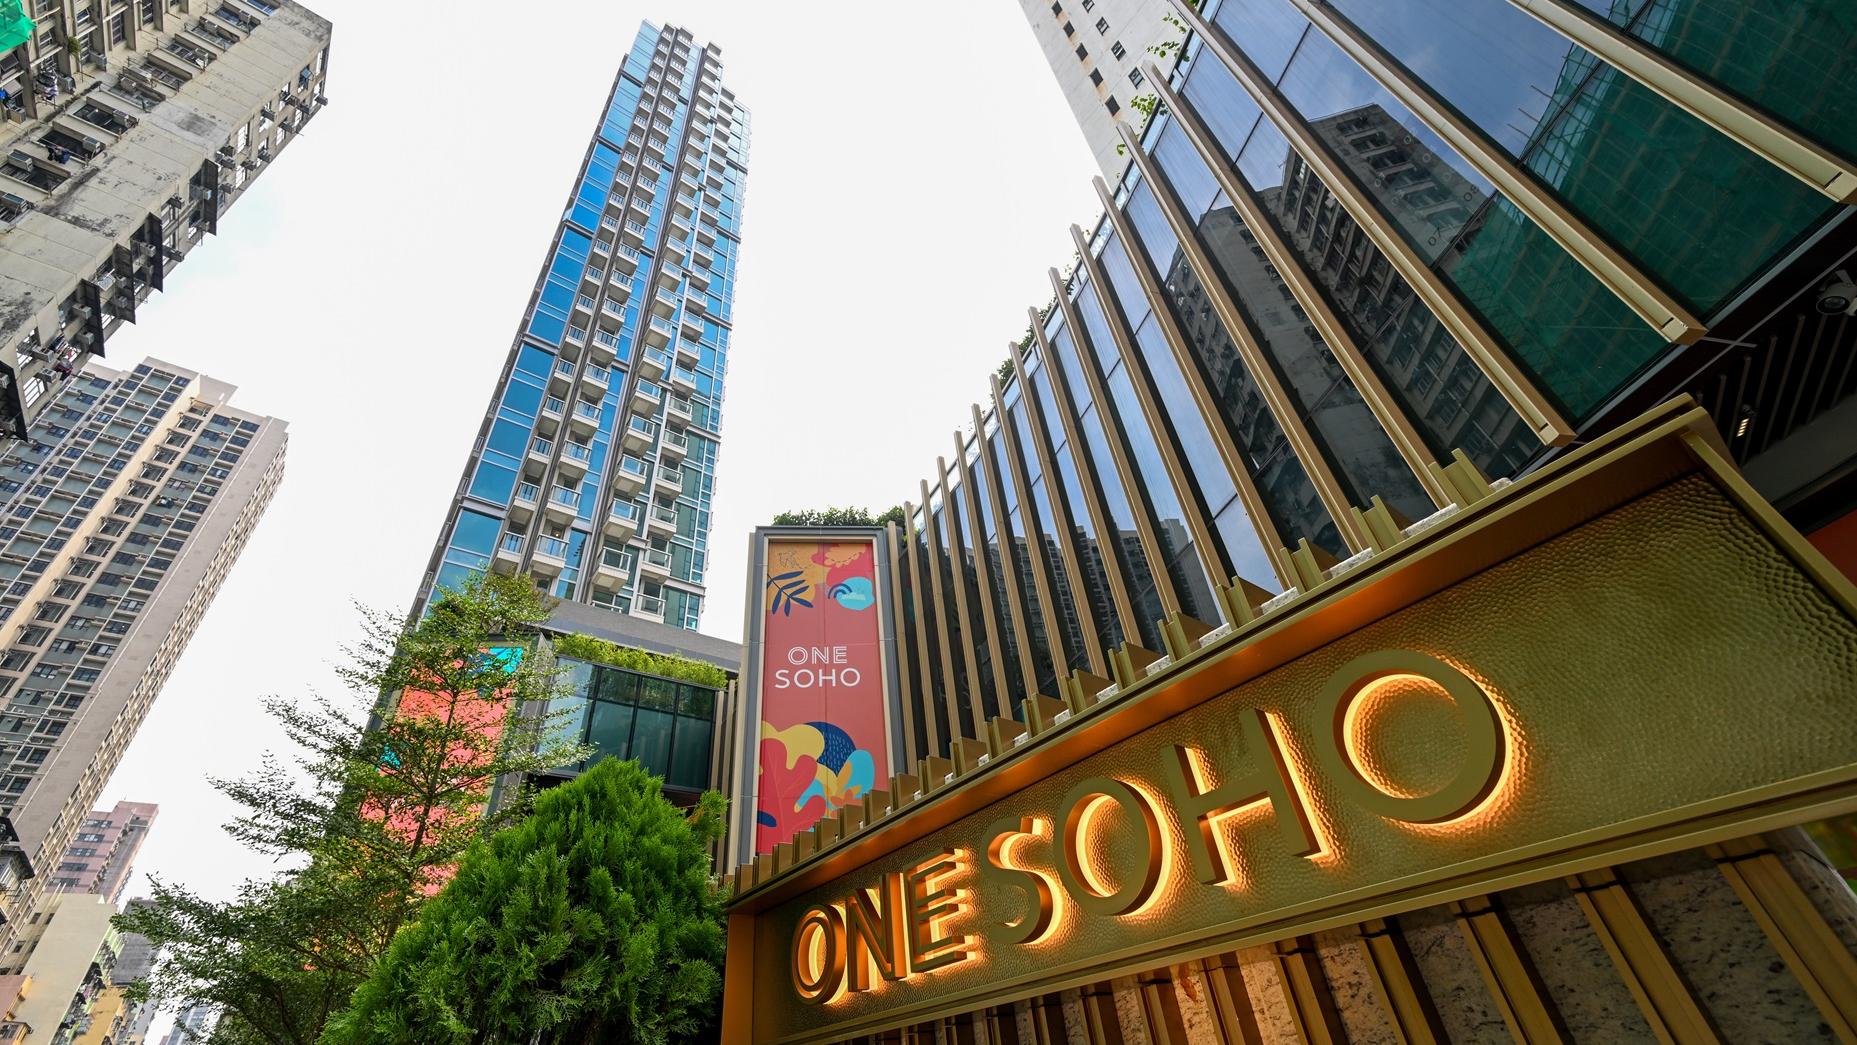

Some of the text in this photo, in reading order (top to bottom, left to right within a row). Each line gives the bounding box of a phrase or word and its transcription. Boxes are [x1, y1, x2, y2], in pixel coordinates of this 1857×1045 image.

[788, 646, 848, 665] ONE
[775, 668, 861, 689] SOHO
[792, 649, 1511, 1005] ONE SOHO
